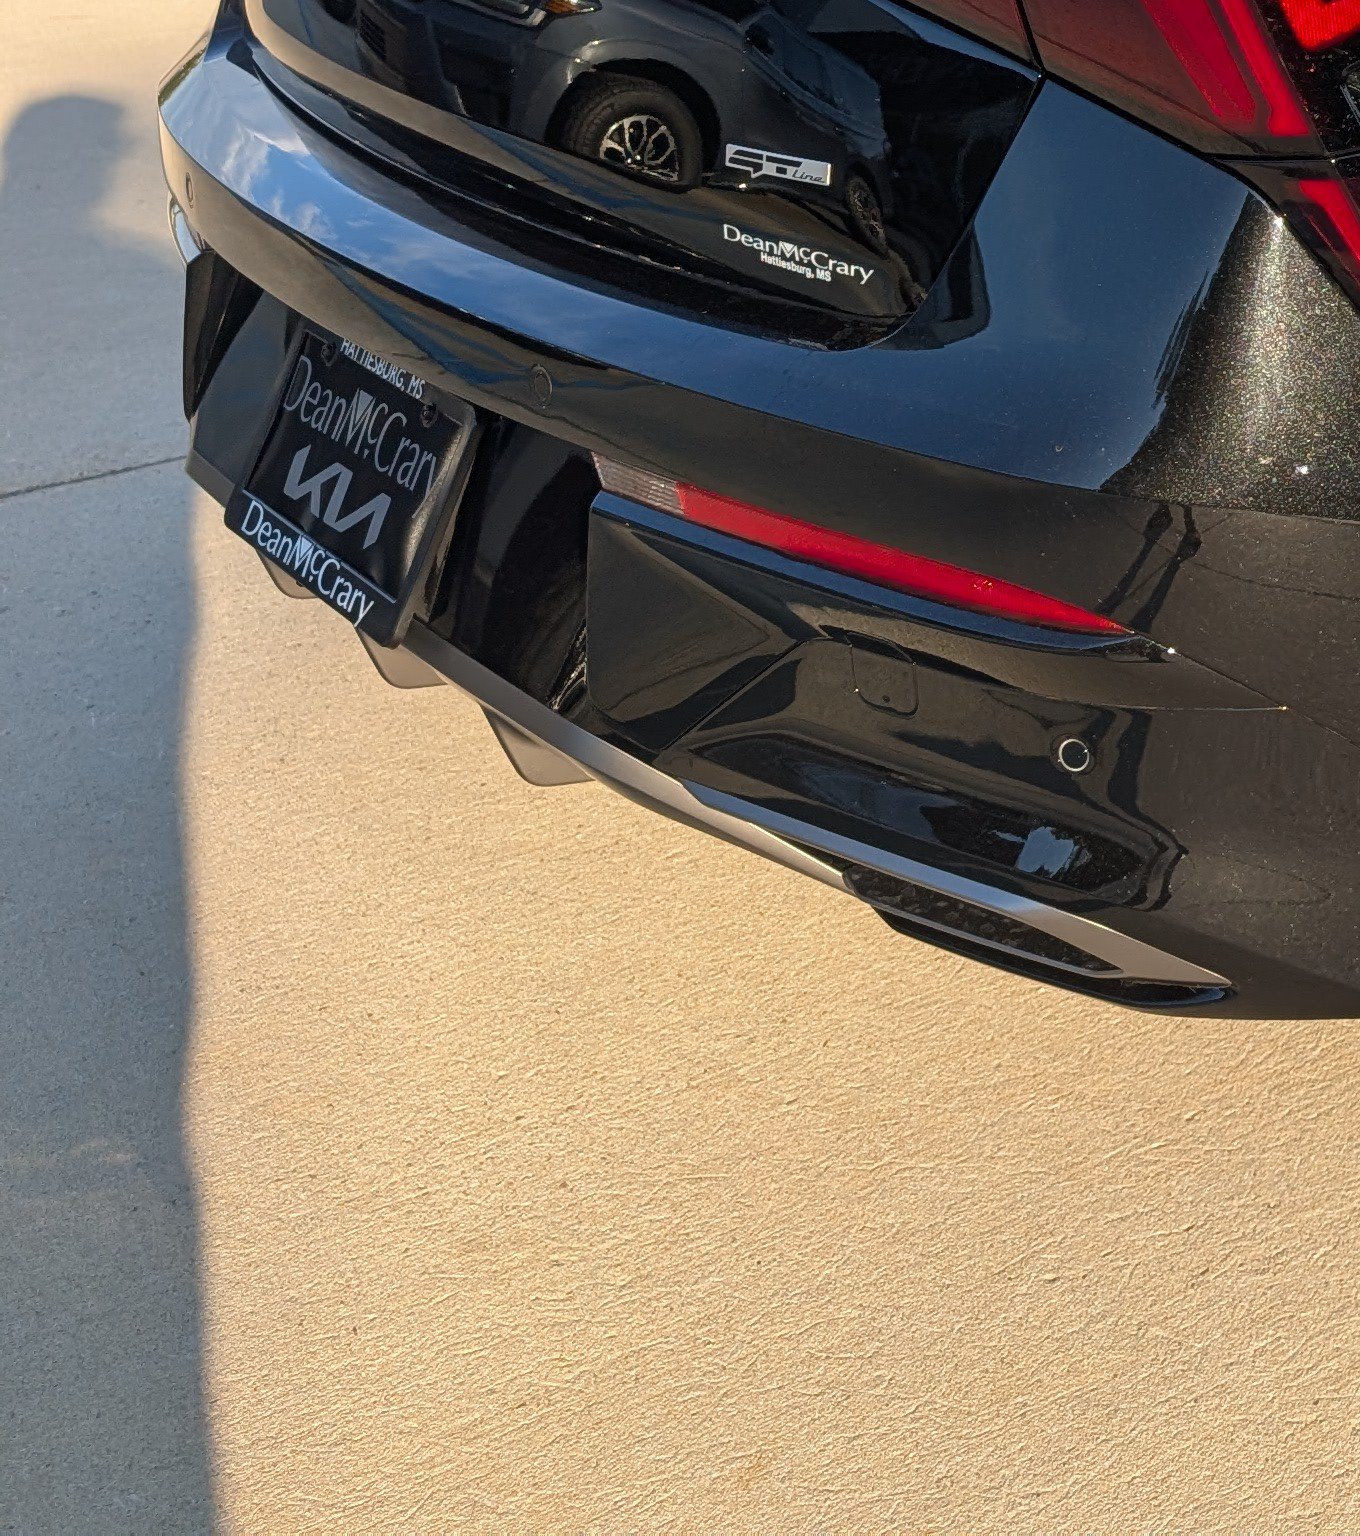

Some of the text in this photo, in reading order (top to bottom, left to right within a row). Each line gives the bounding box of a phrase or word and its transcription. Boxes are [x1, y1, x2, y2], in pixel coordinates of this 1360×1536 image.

[760, 252, 832, 282] Hattiesburg, MS
[406, 374, 426, 399] MS
[283, 444, 392, 550] KIA
